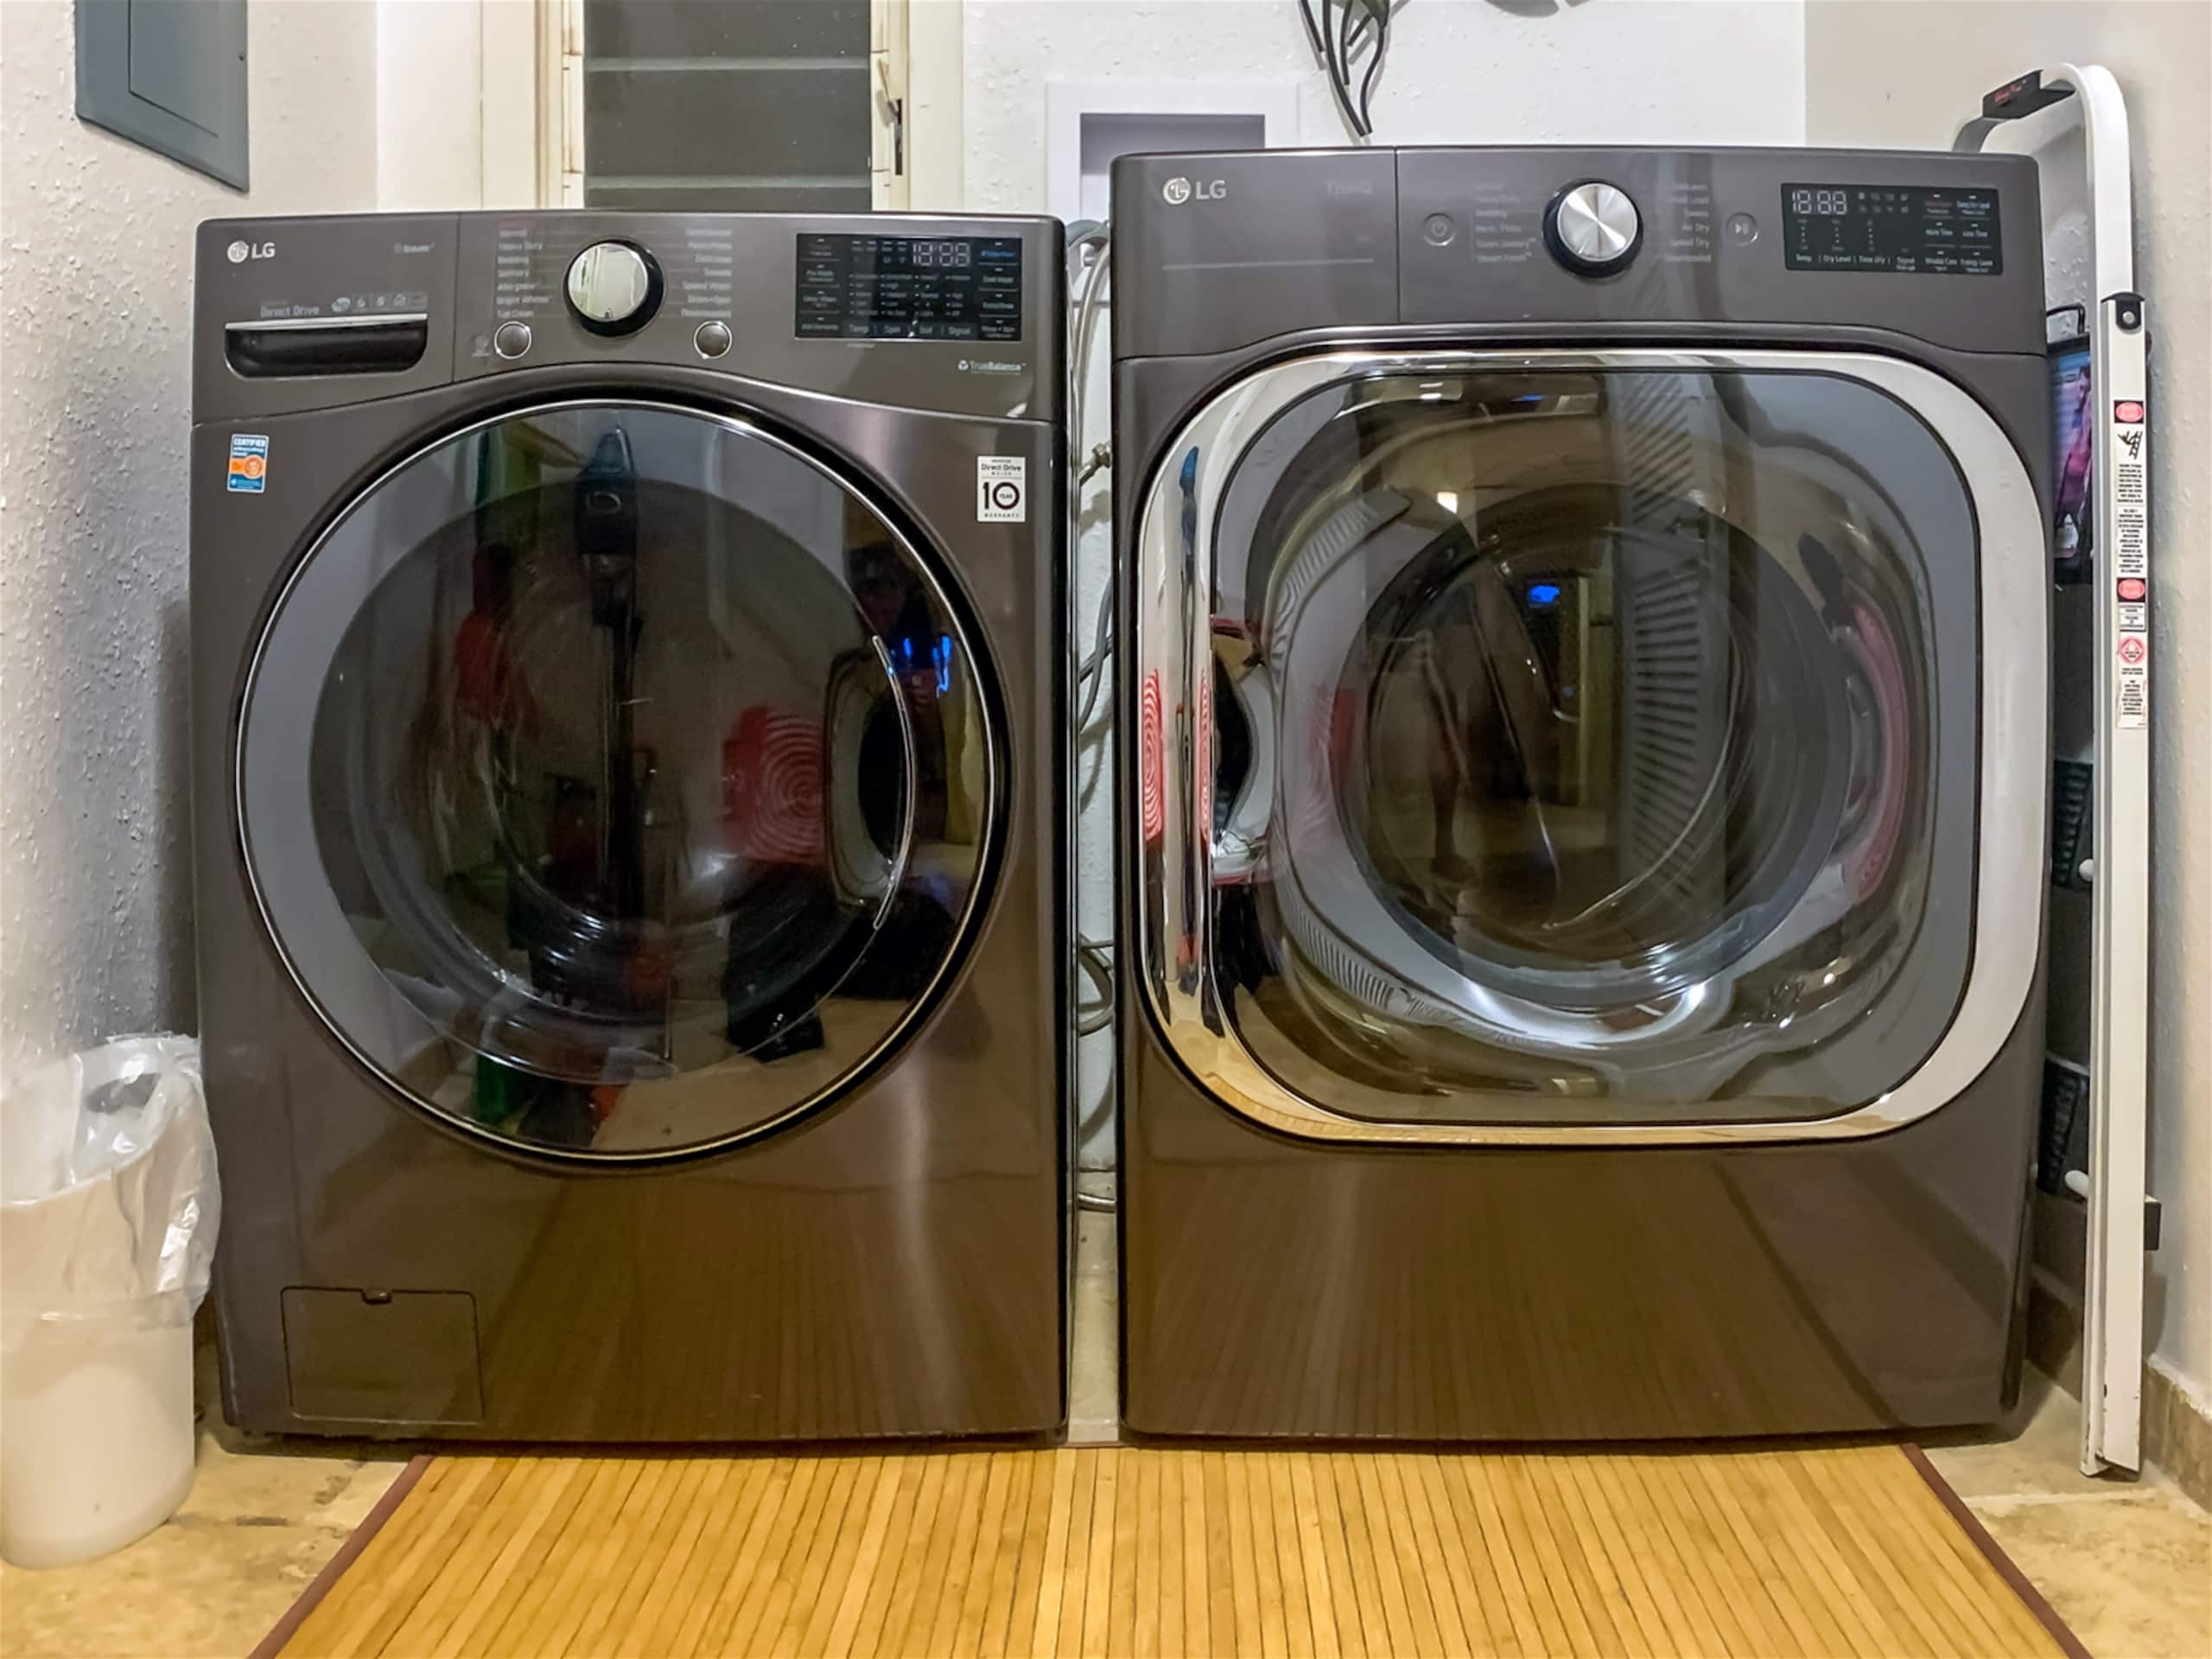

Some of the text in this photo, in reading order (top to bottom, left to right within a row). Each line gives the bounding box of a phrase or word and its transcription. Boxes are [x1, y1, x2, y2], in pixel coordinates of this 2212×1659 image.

[1195, 180, 1227, 200] LG
[251, 242, 276, 259] LG
[982, 480, 1020, 511] 10
